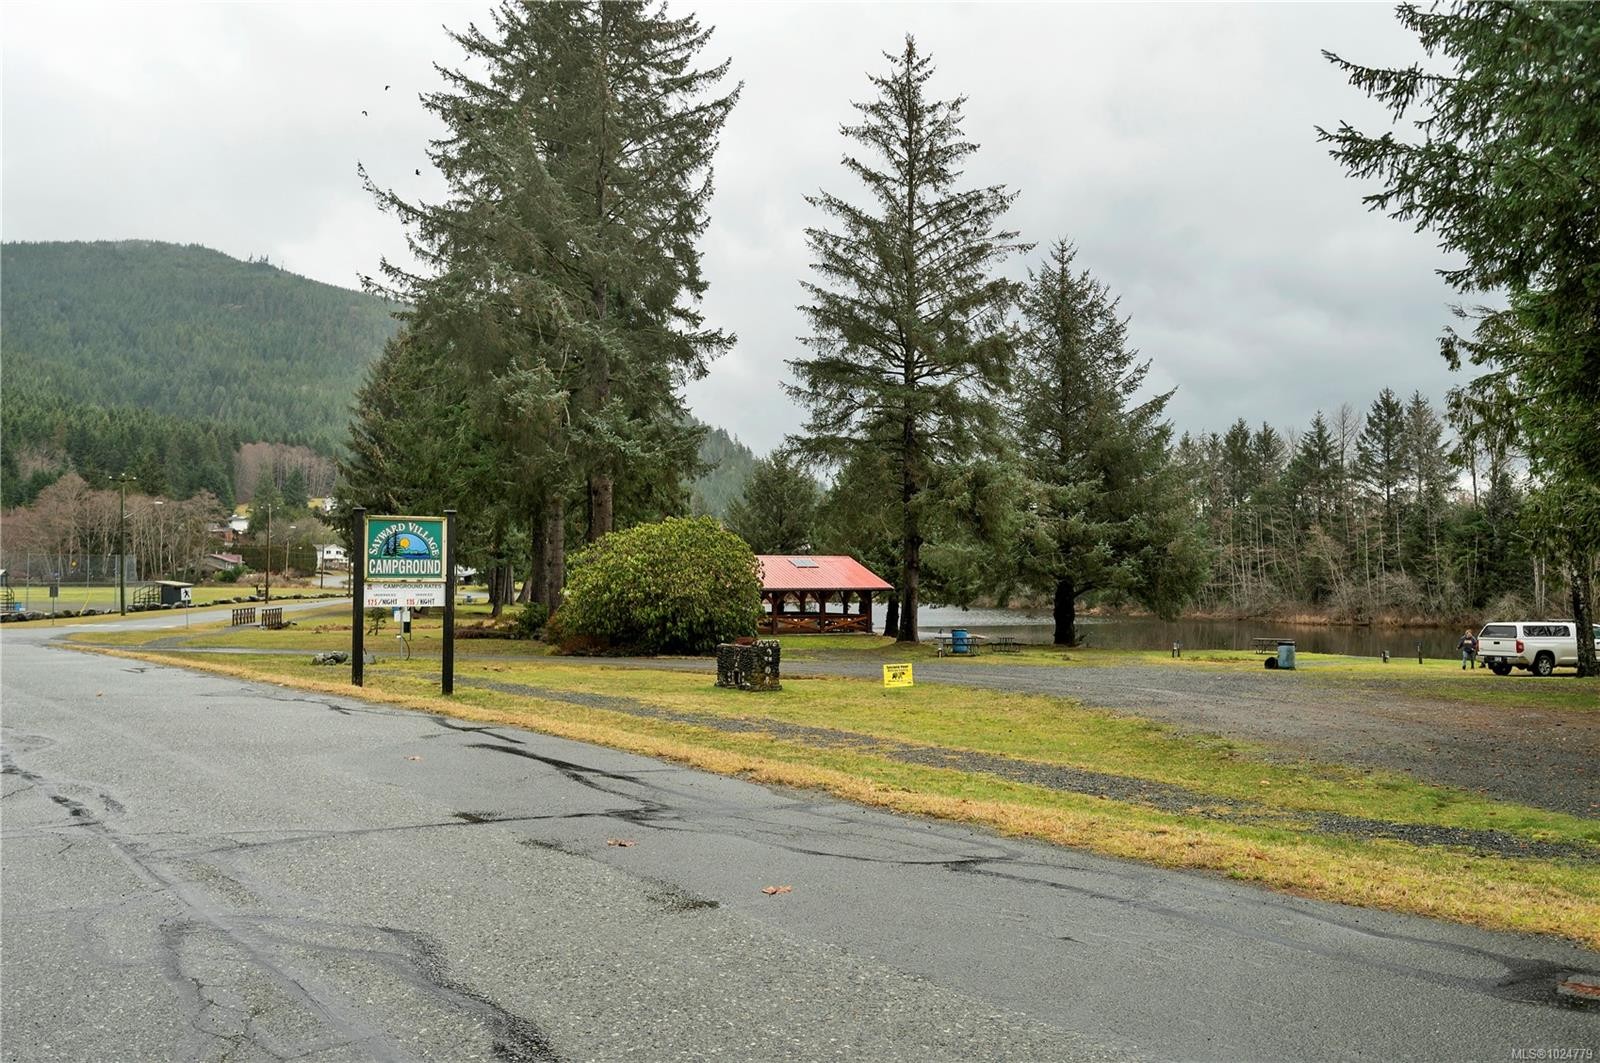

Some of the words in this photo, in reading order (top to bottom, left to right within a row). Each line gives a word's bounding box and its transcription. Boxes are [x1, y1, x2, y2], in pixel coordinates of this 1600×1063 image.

[369, 523, 405, 555] SAYWARD
[408, 522, 440, 556] VILLAGE
[368, 559, 440, 574] CAMPGROUND
